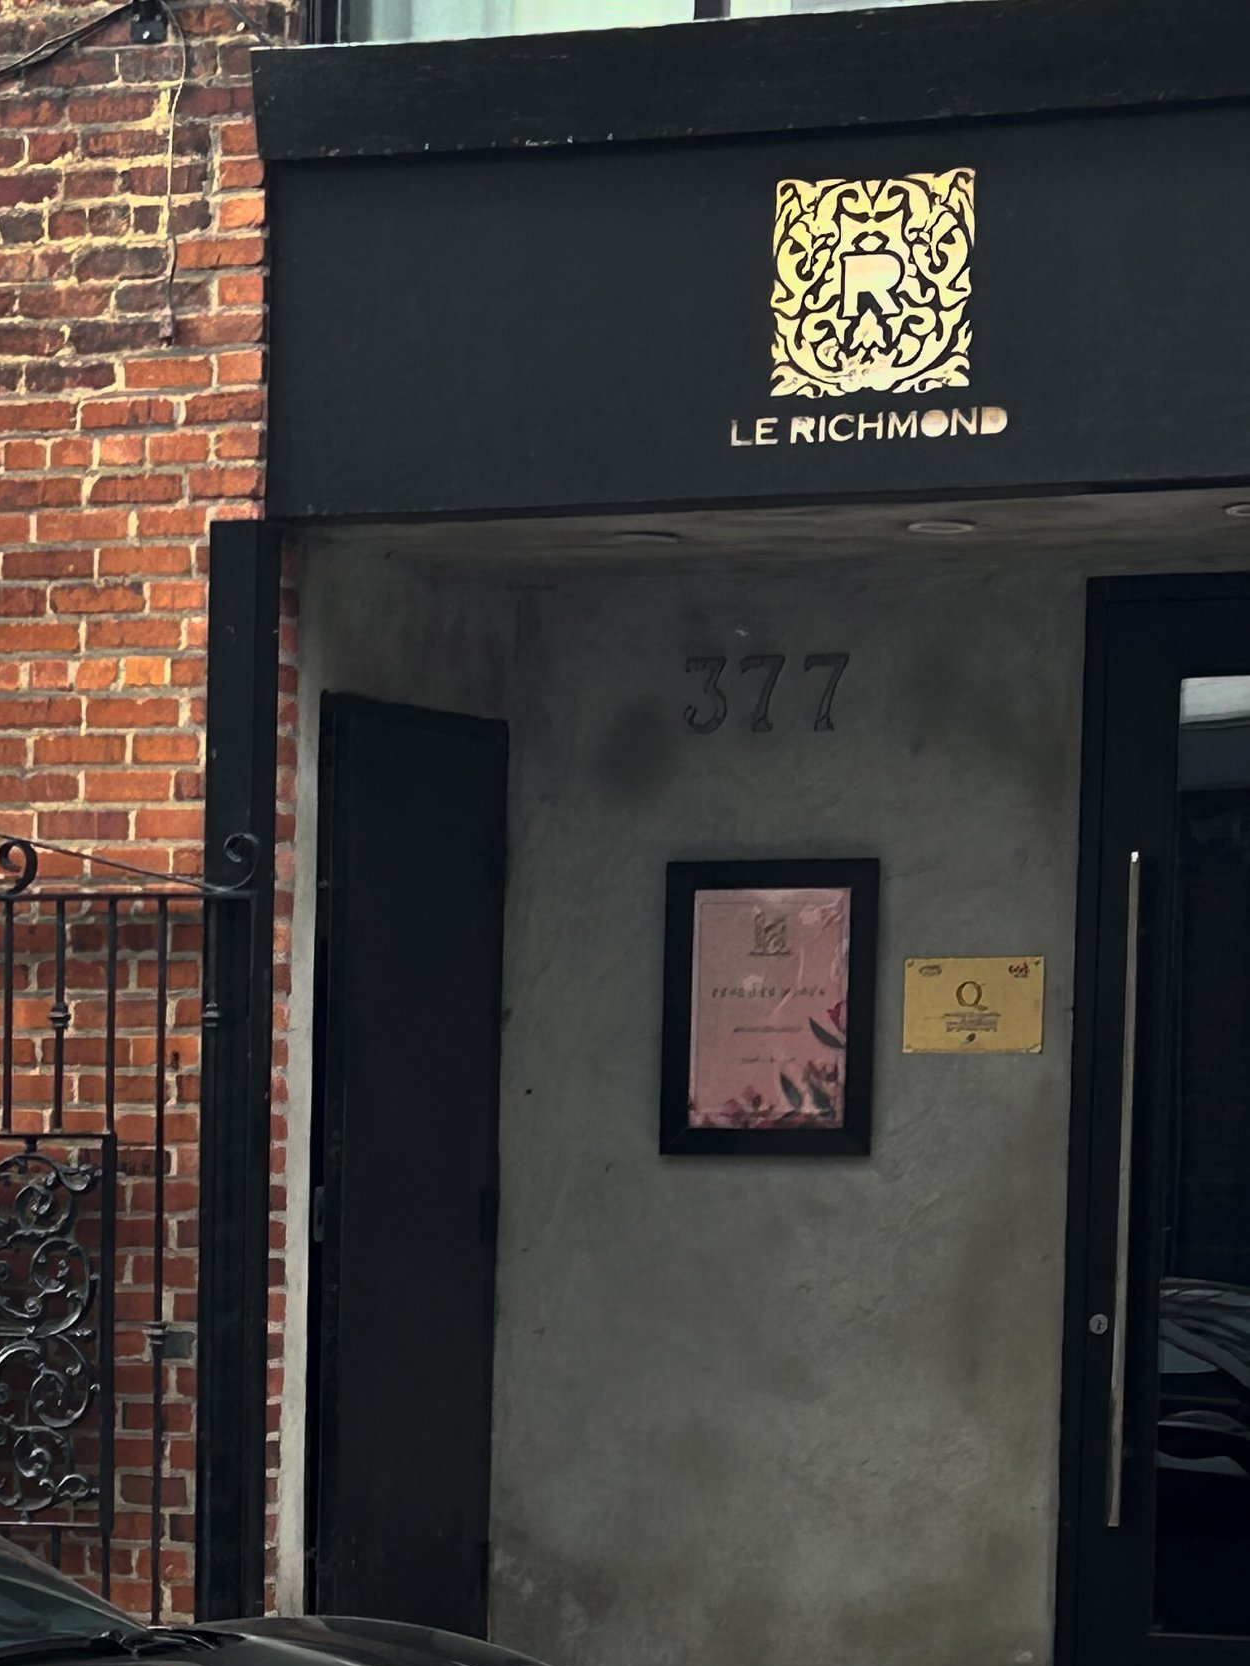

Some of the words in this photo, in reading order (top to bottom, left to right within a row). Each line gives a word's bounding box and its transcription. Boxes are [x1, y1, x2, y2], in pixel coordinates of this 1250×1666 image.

[731, 416, 779, 446] LE
[789, 406, 1008, 444] RICHMOND
[682, 652, 851, 735] 377
